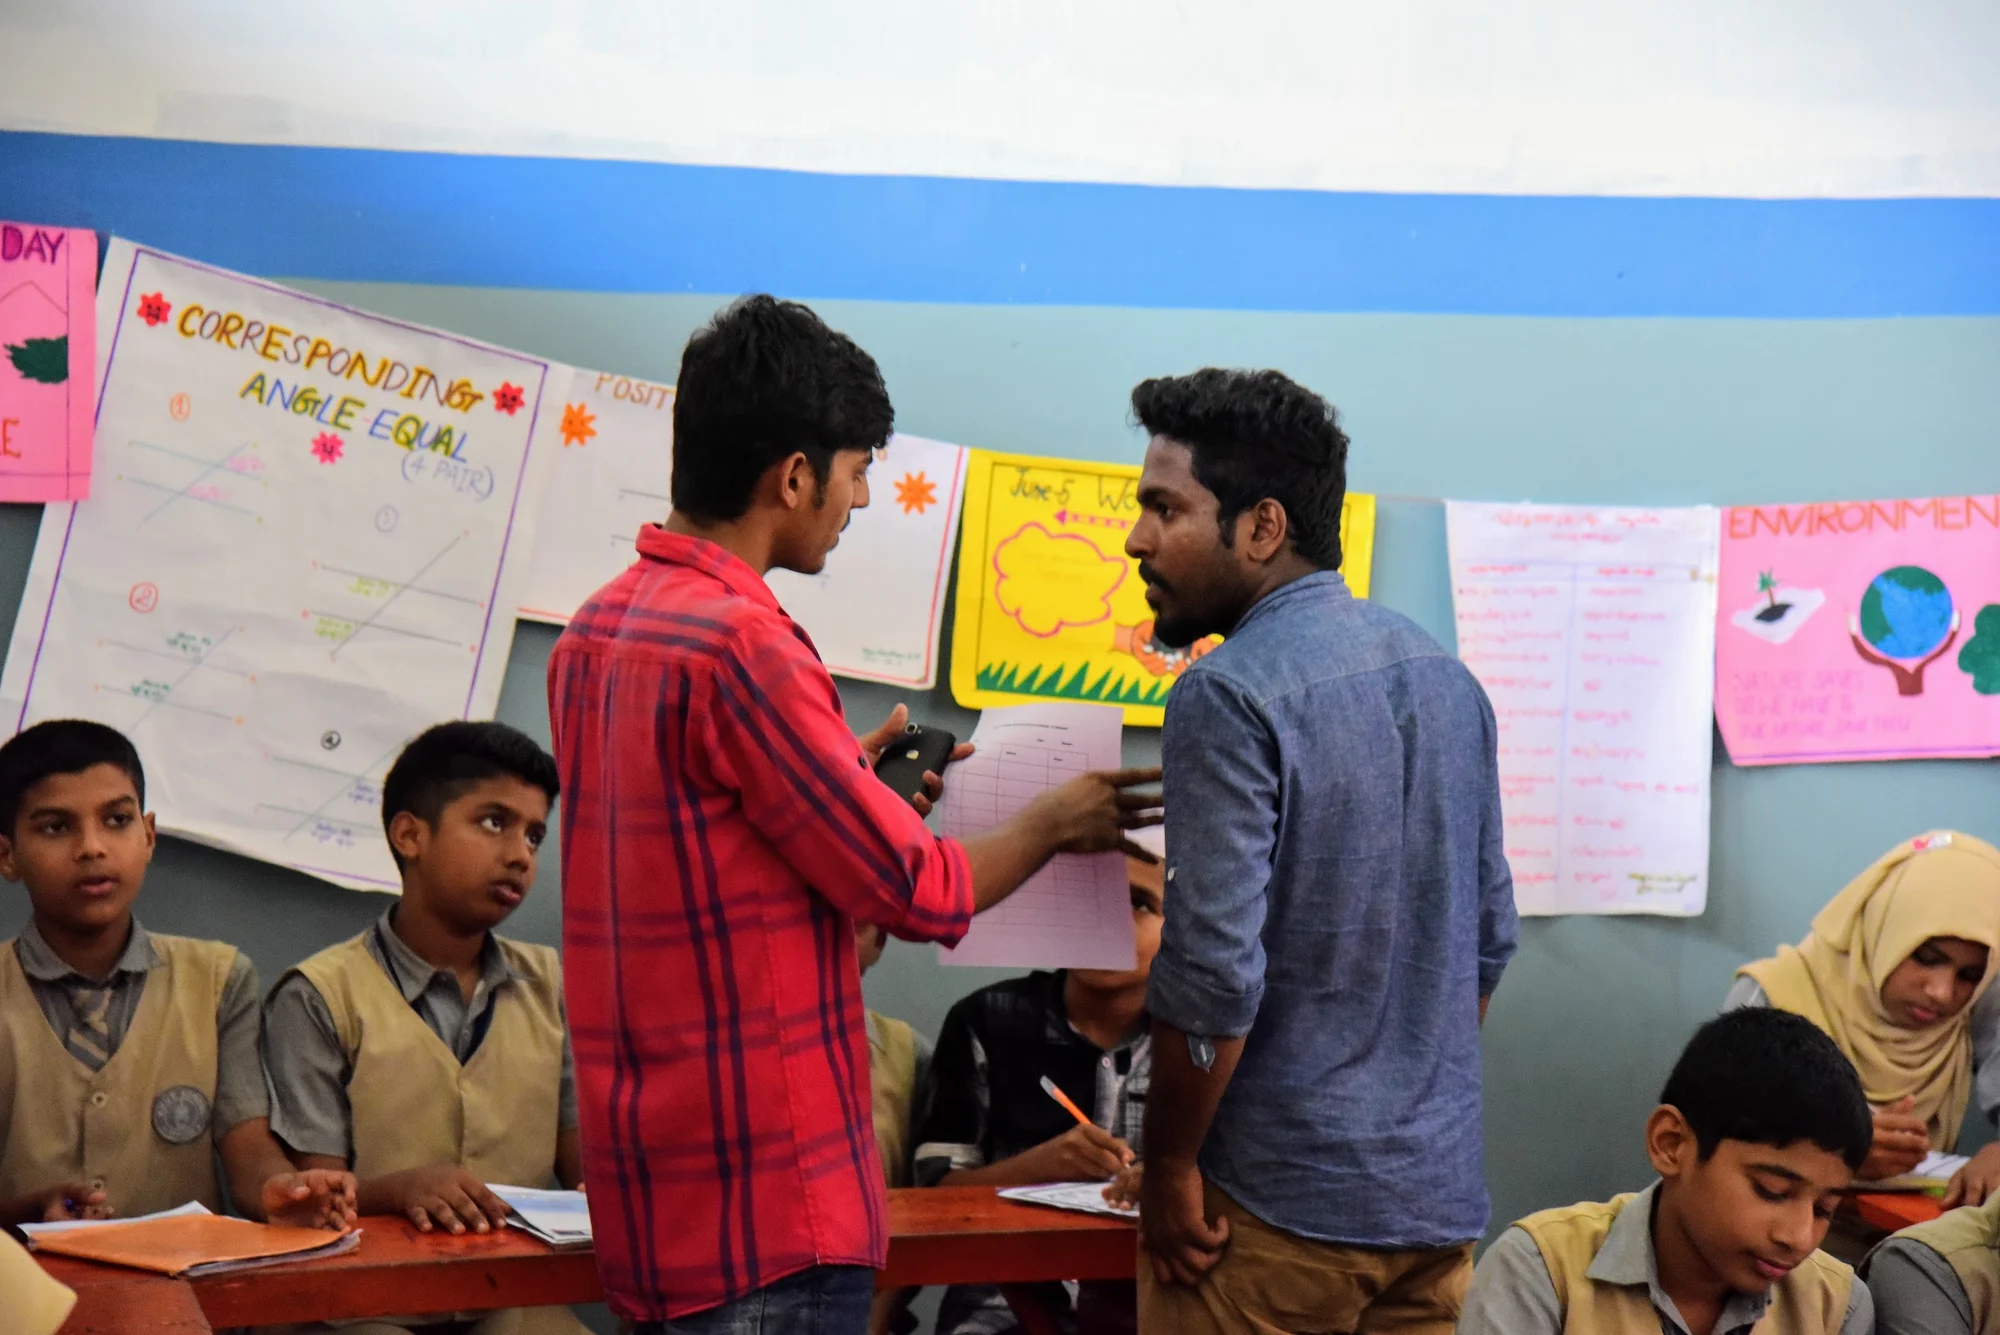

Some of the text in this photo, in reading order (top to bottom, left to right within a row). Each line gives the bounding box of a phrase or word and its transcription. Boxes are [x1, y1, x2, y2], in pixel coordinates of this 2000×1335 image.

[2, 224, 65, 264] DAY
[177, 304, 485, 414] CORRESPONDING
[595, 371, 676, 409] POSIT
[239, 371, 467, 463] ANGLE EQUAL
[0, 419, 21, 458] E
[1728, 495, 2000, 540] ENVIRONMEN
